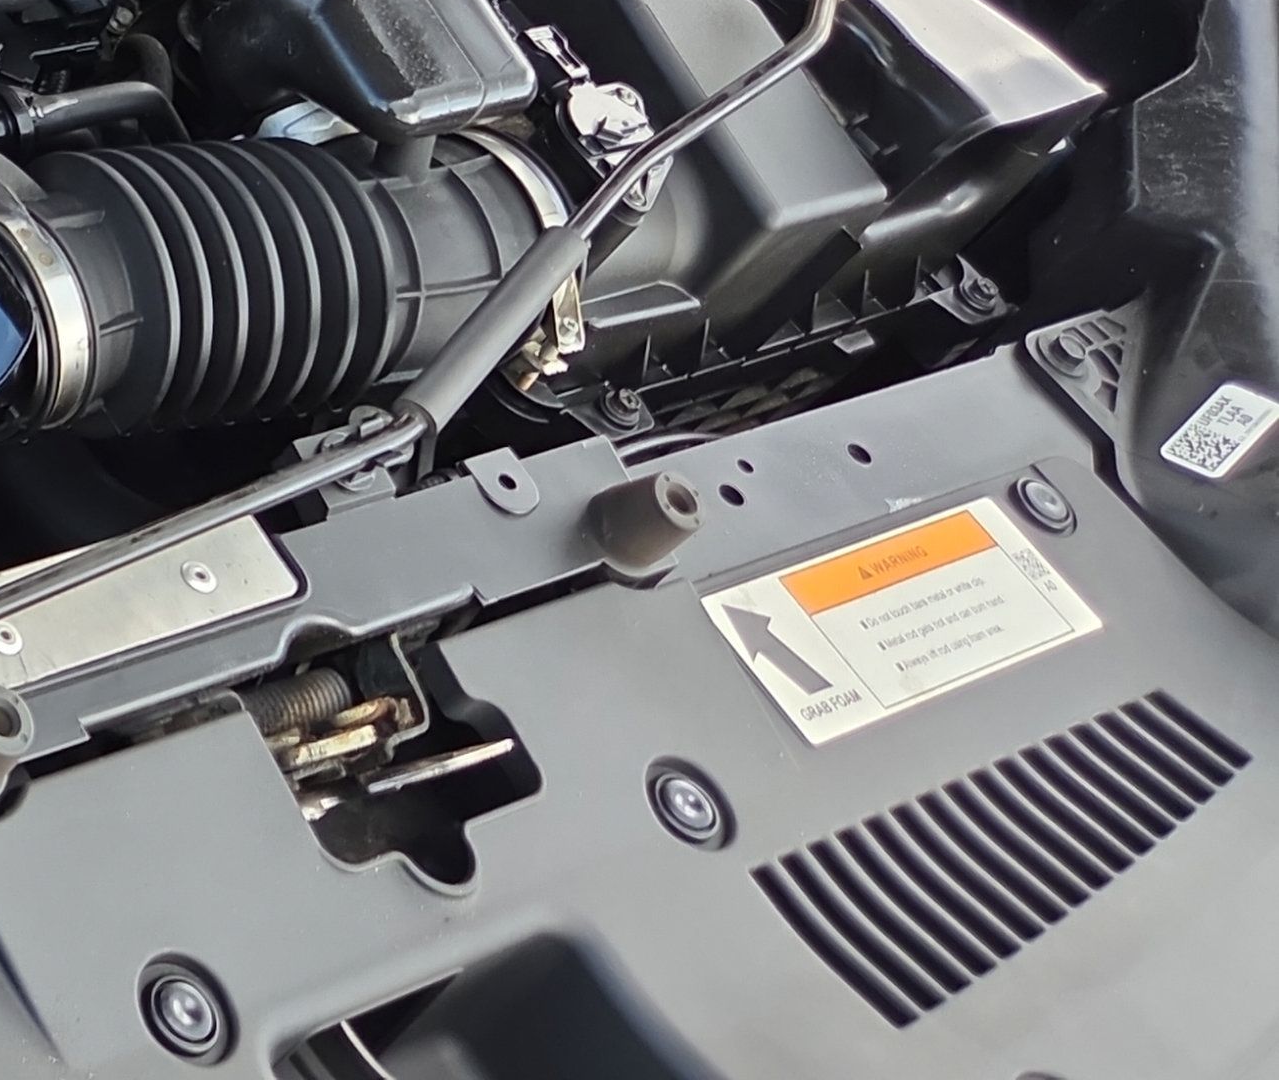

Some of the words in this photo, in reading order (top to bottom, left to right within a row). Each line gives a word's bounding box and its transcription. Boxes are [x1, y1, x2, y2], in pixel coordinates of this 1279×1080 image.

[872, 546, 928, 574] WARNING
[800, 699, 831, 721] GRAB
[829, 687, 861, 709] FOAM
